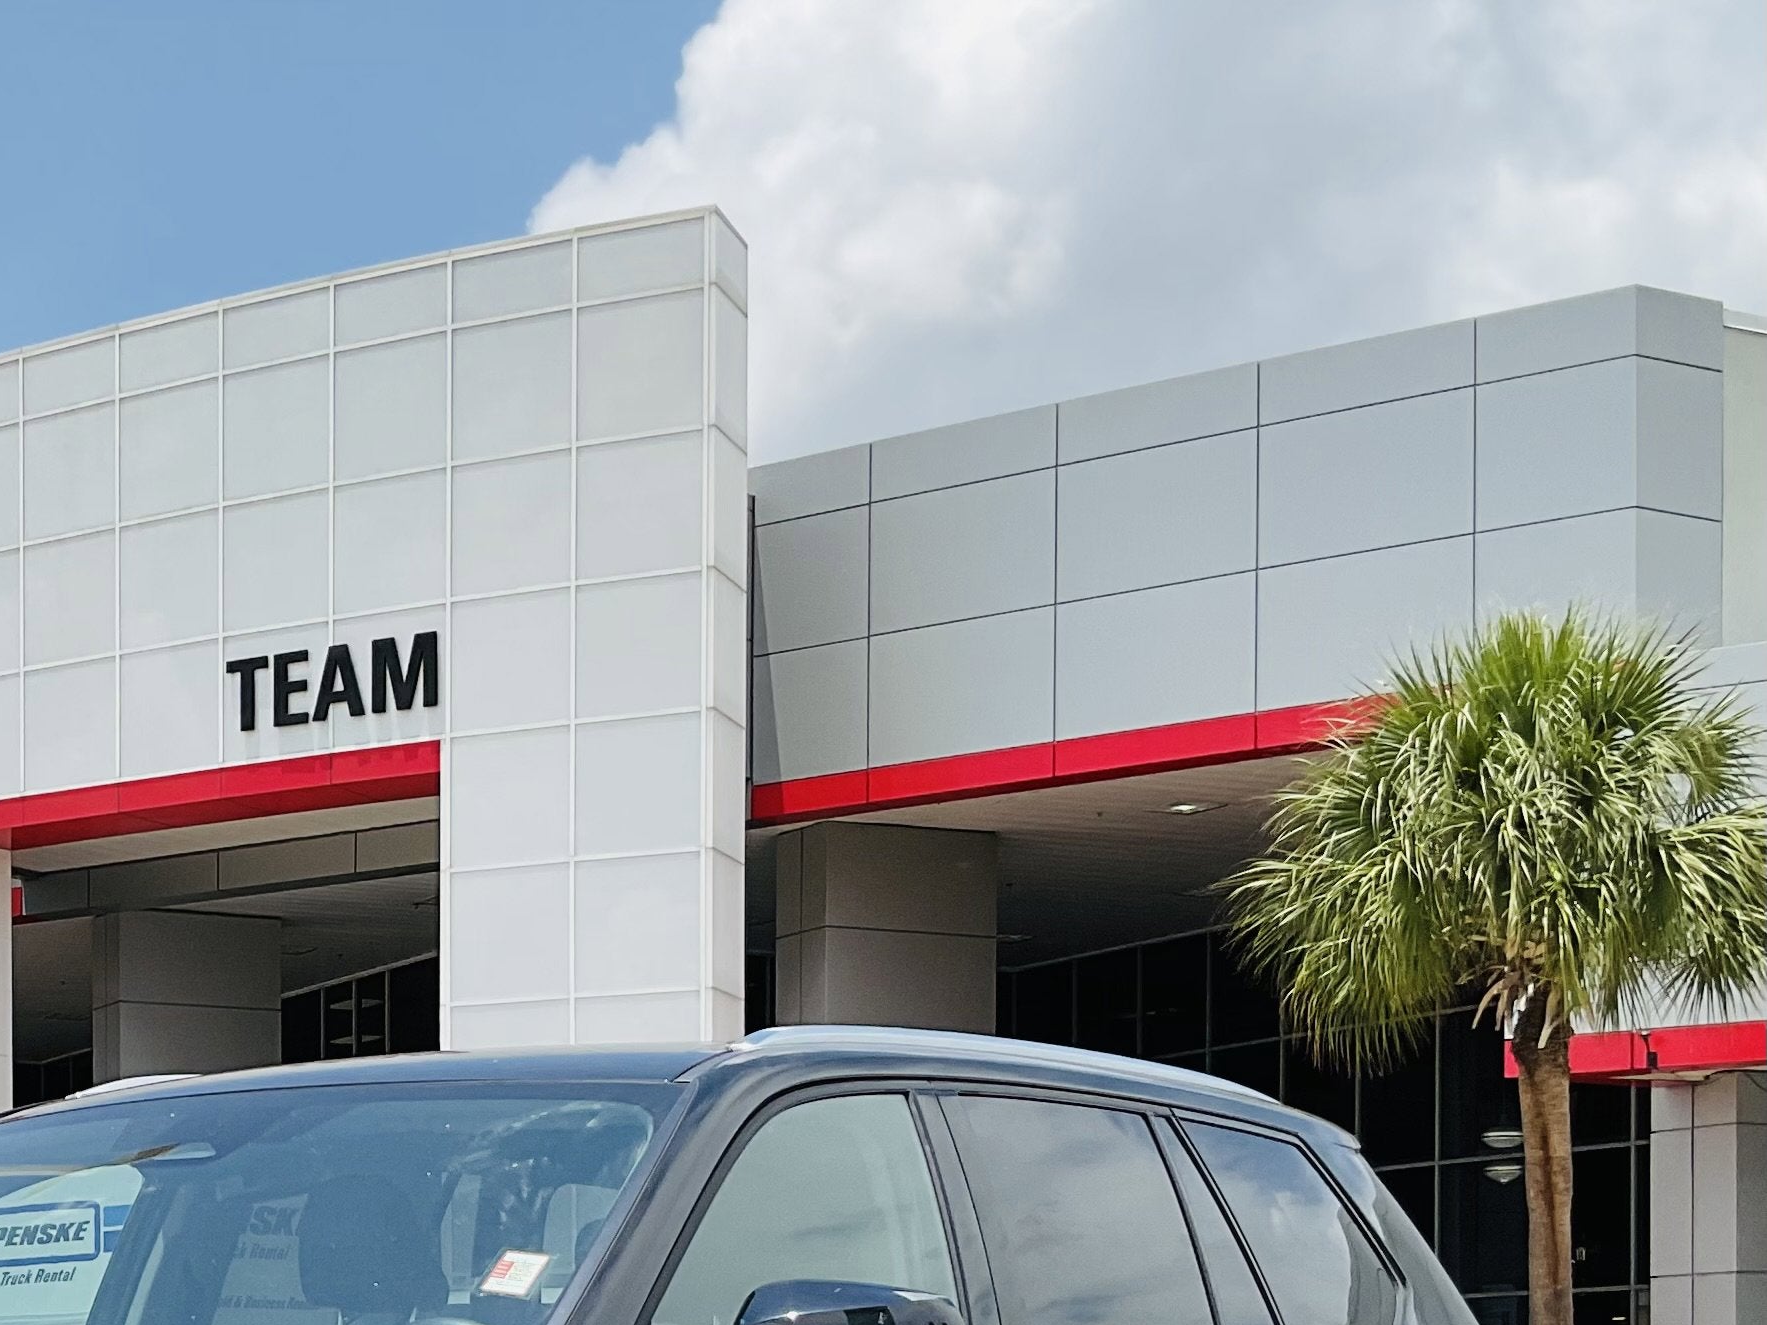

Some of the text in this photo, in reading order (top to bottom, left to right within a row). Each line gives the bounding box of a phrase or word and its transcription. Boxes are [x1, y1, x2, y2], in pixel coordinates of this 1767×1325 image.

[226, 630, 438, 731] TEAM
[0, 1266, 77, 1287] Truck Rental
